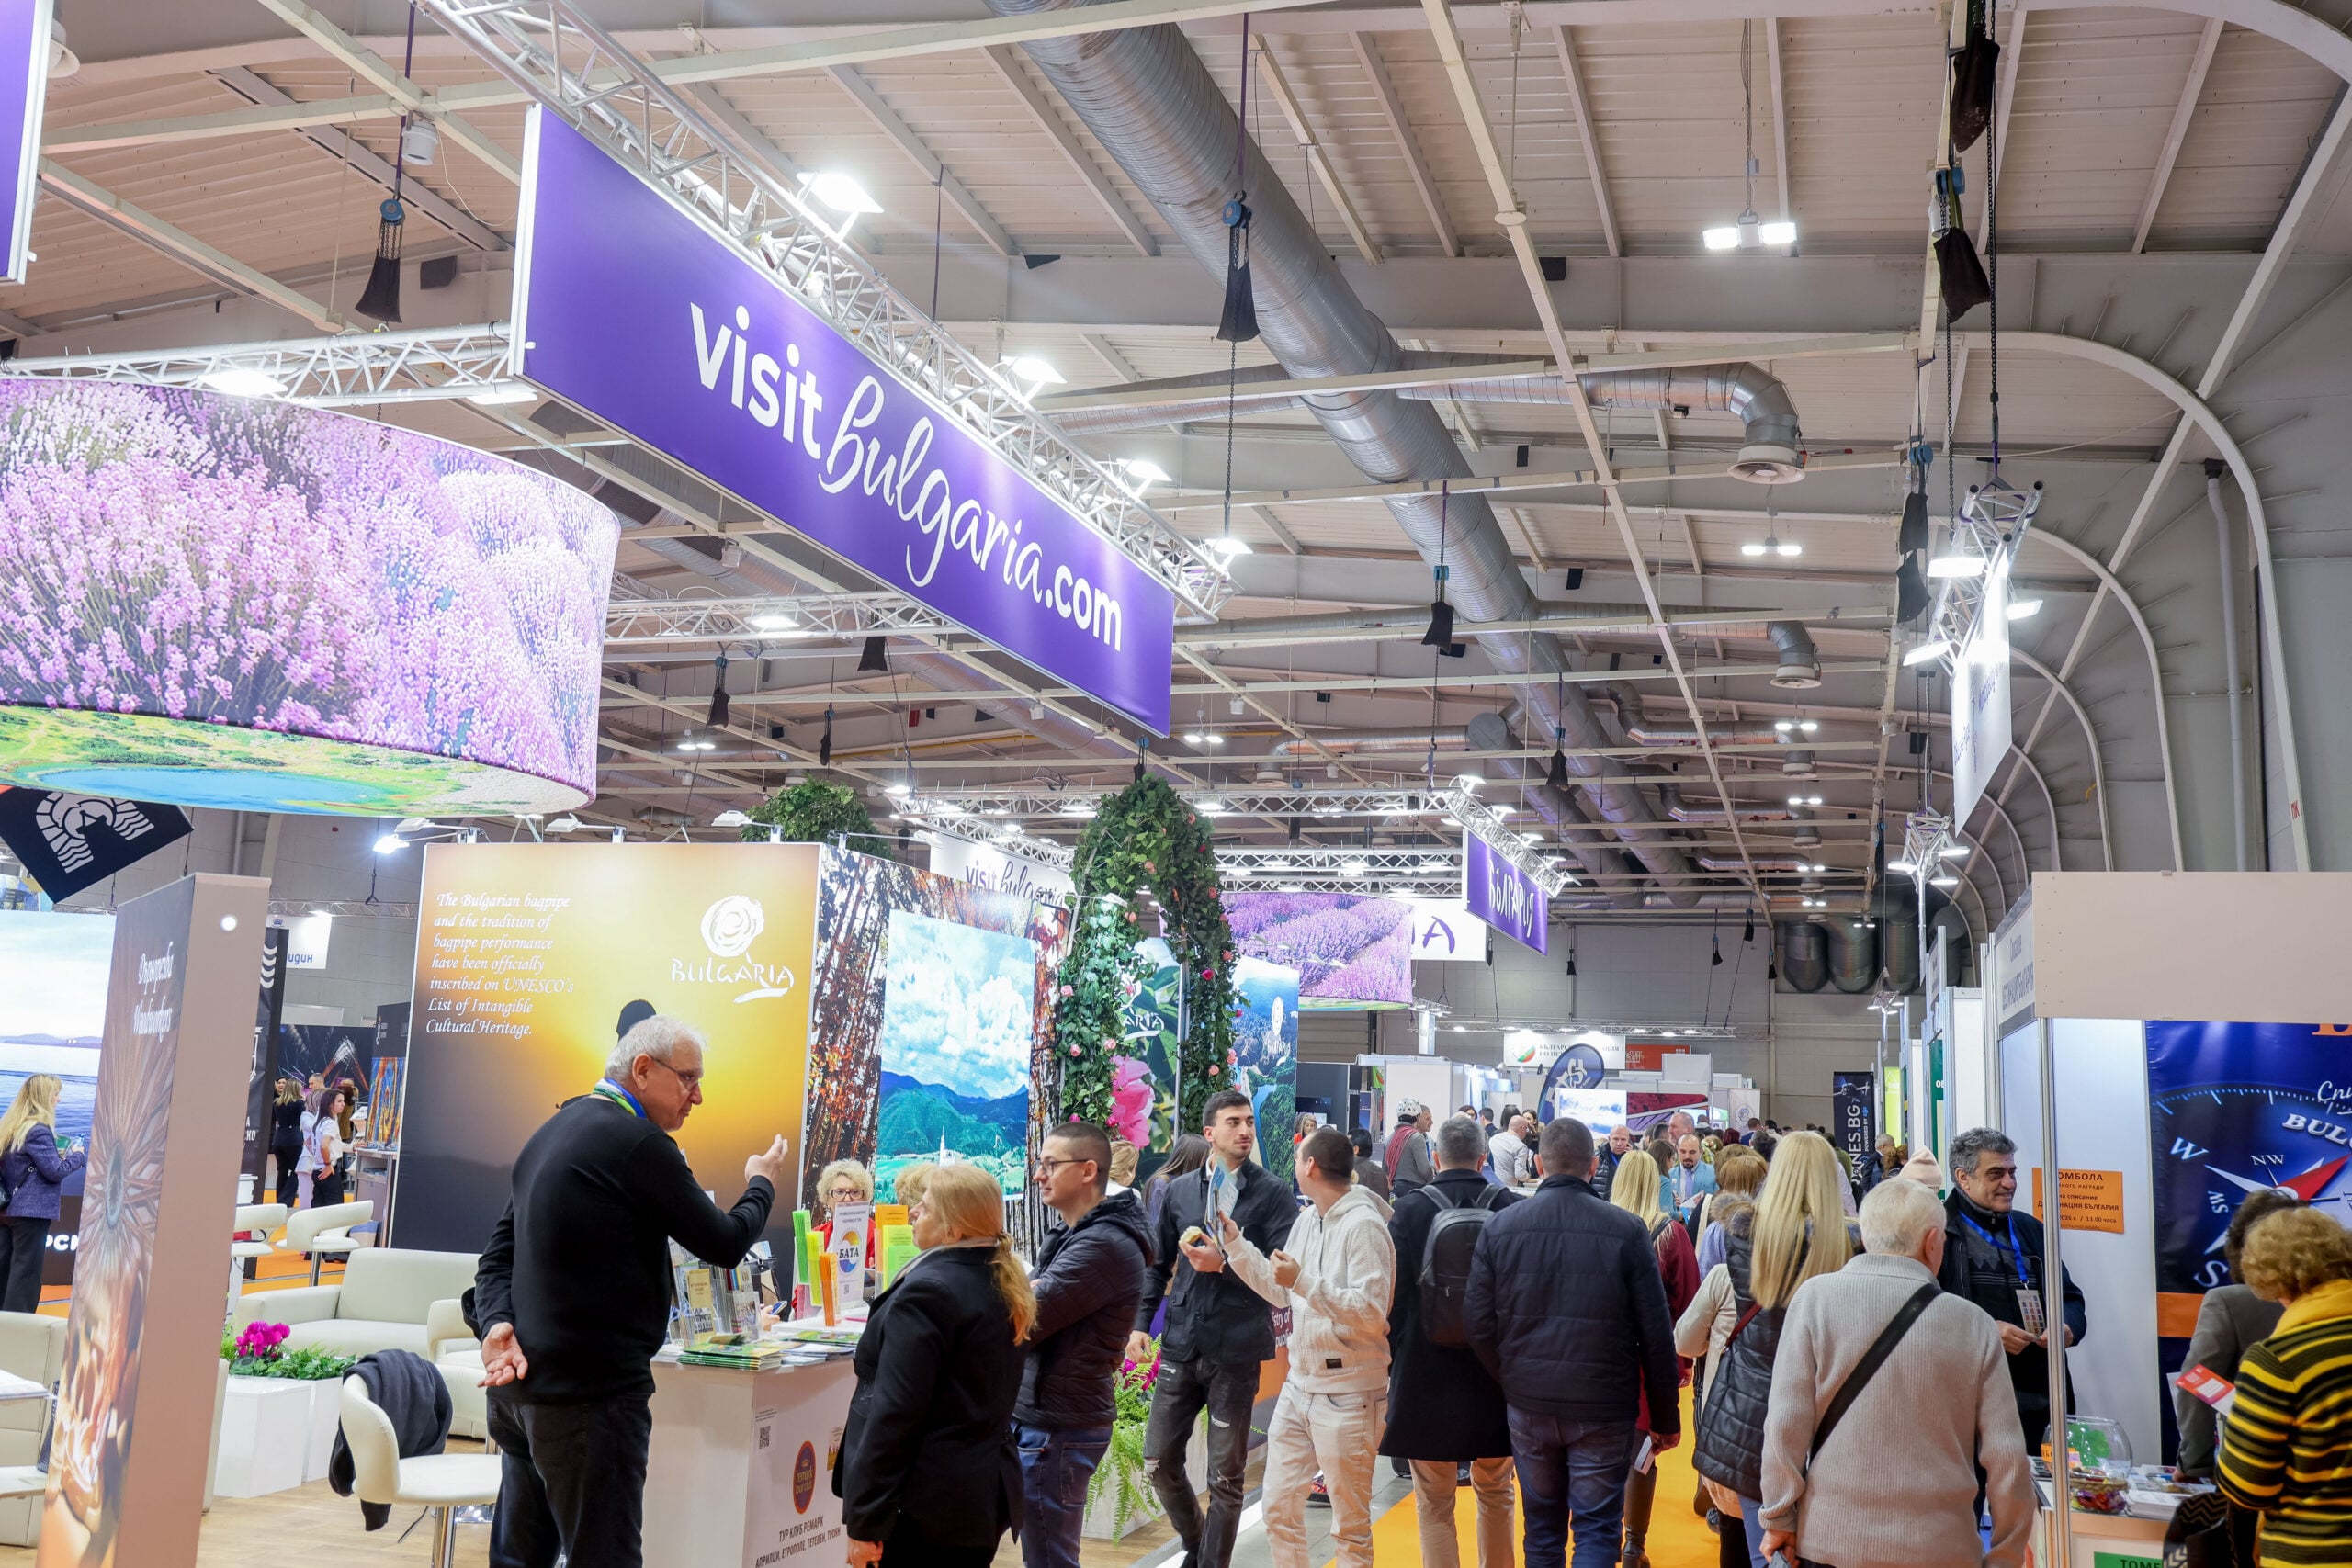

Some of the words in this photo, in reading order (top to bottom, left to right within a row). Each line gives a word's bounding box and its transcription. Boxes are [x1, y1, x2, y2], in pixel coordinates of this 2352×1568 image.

[436, 892, 458, 907] The
[461, 892, 520, 911] Bulgarian
[524, 892, 571, 911] bagpipe
[434, 912, 458, 927] and
[459, 912, 478, 928] the
[481, 913, 534, 929] tradition
[538, 914, 554, 932] of
[434, 933, 477, 952] bagpipe
[480, 933, 554, 953] performance
[431, 953, 458, 969] have
[462, 953, 488, 970] been
[491, 954, 545, 976] officially
[671, 956, 795, 989] BULGARIA
[430, 976, 485, 991] inscribed
[484, 980, 499, 992] on
[427, 997, 452, 1011] List
[455, 997, 471, 1016] of
[470, 998, 534, 1017] Intangible
[426, 1018, 479, 1033] Cultural
[478, 1020, 533, 1039] Heritage.
[2170, 1137, 2210, 1160] W
[2250, 1154, 2285, 1166] NW
[2085, 1203, 2120, 1212] БЪЛГАРИЯ
[839, 1247, 859, 1259] БАТА
[779, 1529, 788, 1542] ТУР
[789, 1523, 803, 1538] КЛУБ
[803, 1516, 823, 1533] РЕМАРК
